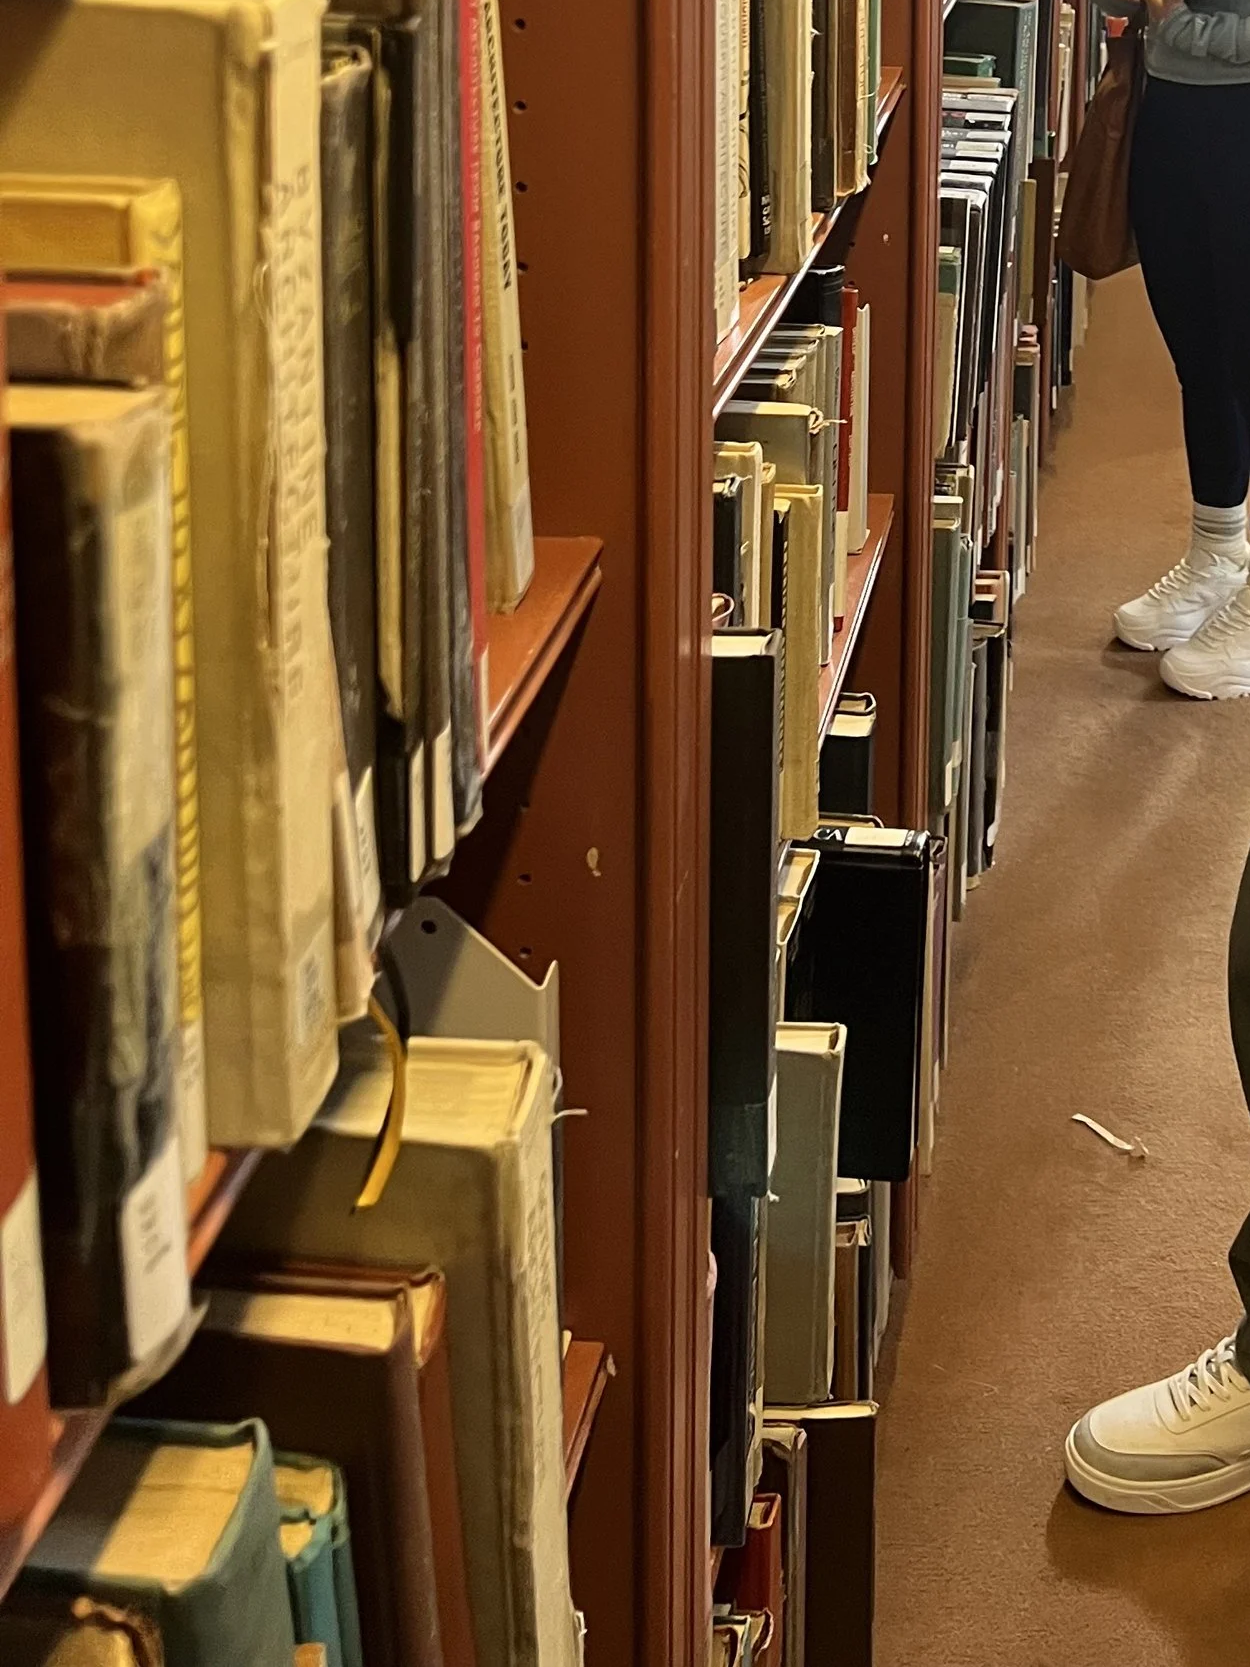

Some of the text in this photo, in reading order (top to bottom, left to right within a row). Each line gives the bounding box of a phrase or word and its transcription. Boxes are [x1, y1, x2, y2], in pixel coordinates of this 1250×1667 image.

[485, 0, 507, 198] ARCHITECTURE
[499, 203, 513, 292] TODAY
[273, 181, 304, 700] ARCHITECTURE
